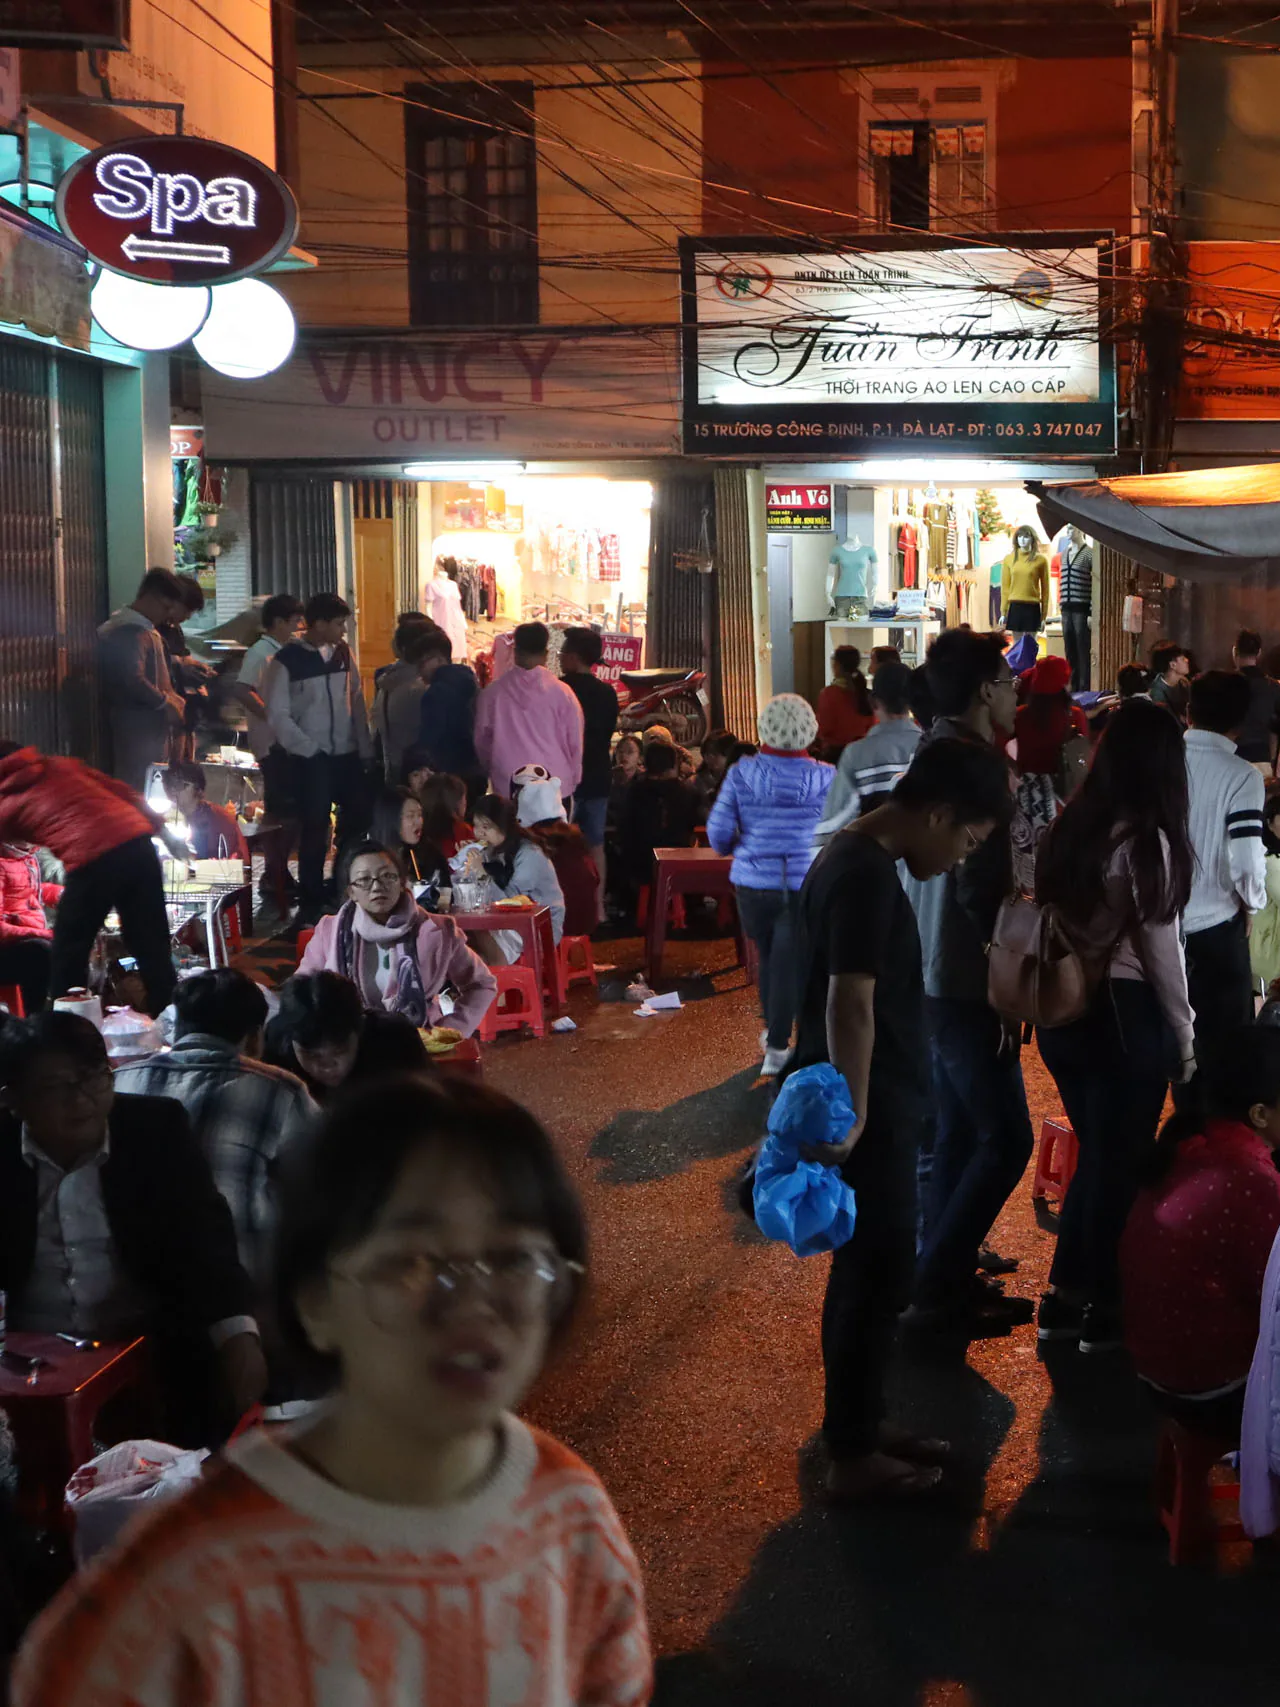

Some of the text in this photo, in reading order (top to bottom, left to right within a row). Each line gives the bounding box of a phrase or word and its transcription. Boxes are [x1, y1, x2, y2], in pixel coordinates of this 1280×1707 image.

[92, 153, 256, 234] Spa
[308, 336, 560, 404] VINCY
[865, 380, 918, 394] TRANG
[953, 380, 983, 394] LEN
[989, 380, 1026, 394] CAO
[1031, 375, 1067, 393] CẤP
[373, 415, 507, 442] OUTLET
[694, 424, 709, 437] 15
[777, 420, 824, 437] CÔNG
[903, 420, 924, 436] ĐÀ
[929, 423, 955, 438] LẠT
[768, 489, 829, 505] Anh Võ
